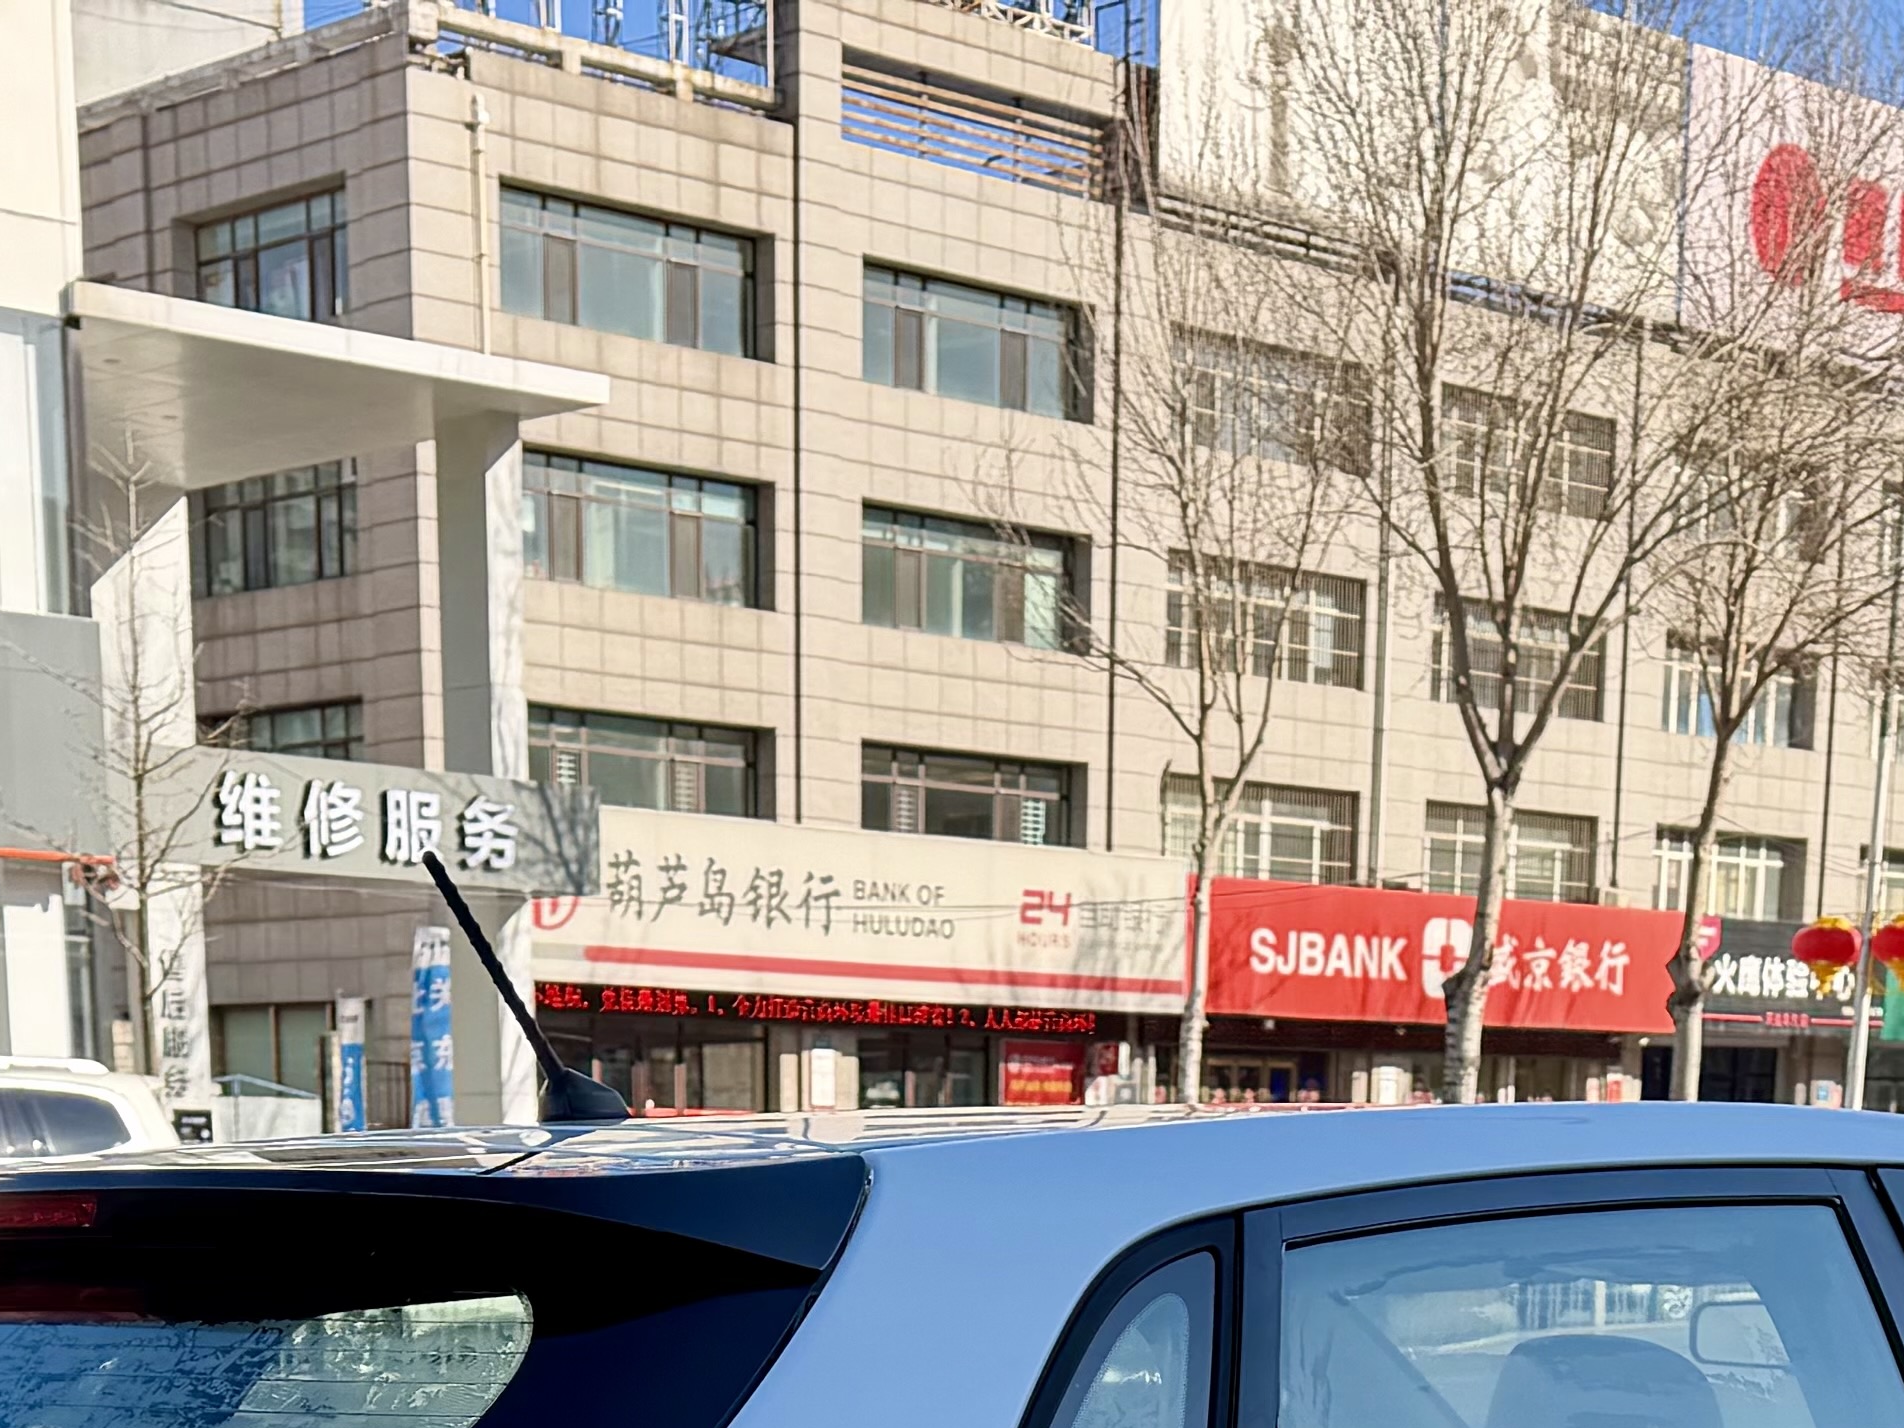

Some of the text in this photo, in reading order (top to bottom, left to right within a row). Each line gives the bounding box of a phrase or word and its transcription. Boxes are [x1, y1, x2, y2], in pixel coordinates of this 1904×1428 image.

[214, 769, 520, 870] 维修服务
[605, 849, 842, 937] 葫芦岛银行
[852, 879, 946, 906] BANK OF
[1018, 889, 1073, 927] 24
[852, 914, 956, 940] HULUDAO
[1249, 926, 1408, 982] SJBANK
